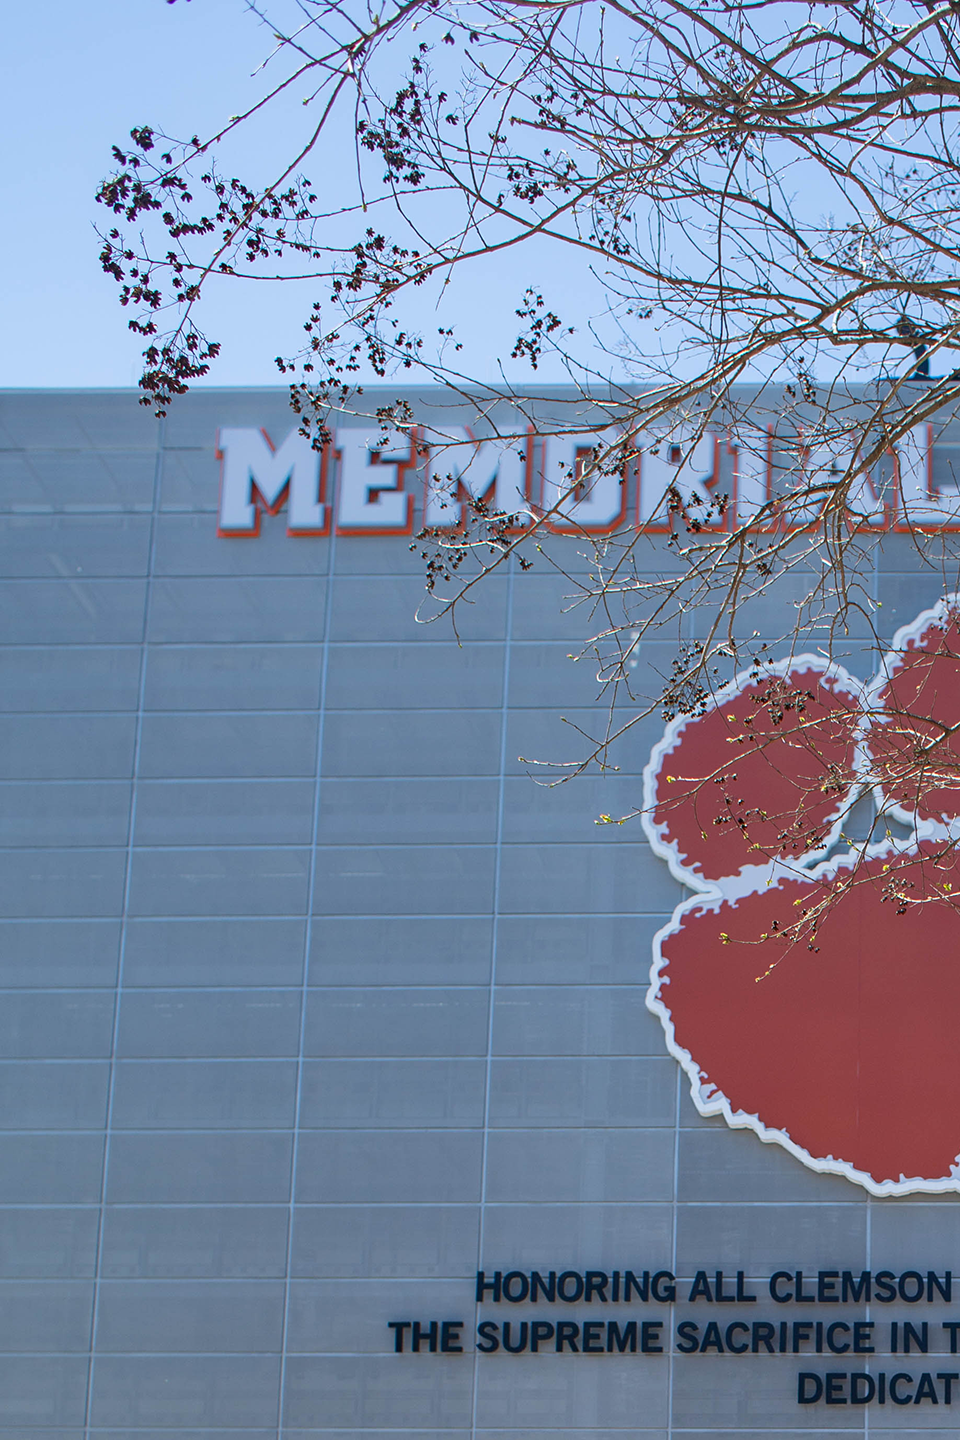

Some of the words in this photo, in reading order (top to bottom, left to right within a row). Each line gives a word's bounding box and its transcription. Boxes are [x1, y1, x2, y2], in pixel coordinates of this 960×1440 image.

[475, 1270, 676, 1303] HONORING
[689, 1270, 756, 1302] ALL
[769, 1270, 952, 1303] CLEMSON
[388, 1321, 464, 1352] THE
[476, 1320, 663, 1353] SUPREME
[676, 1320, 875, 1353] SACRIFICE
[890, 1321, 928, 1353] IN
